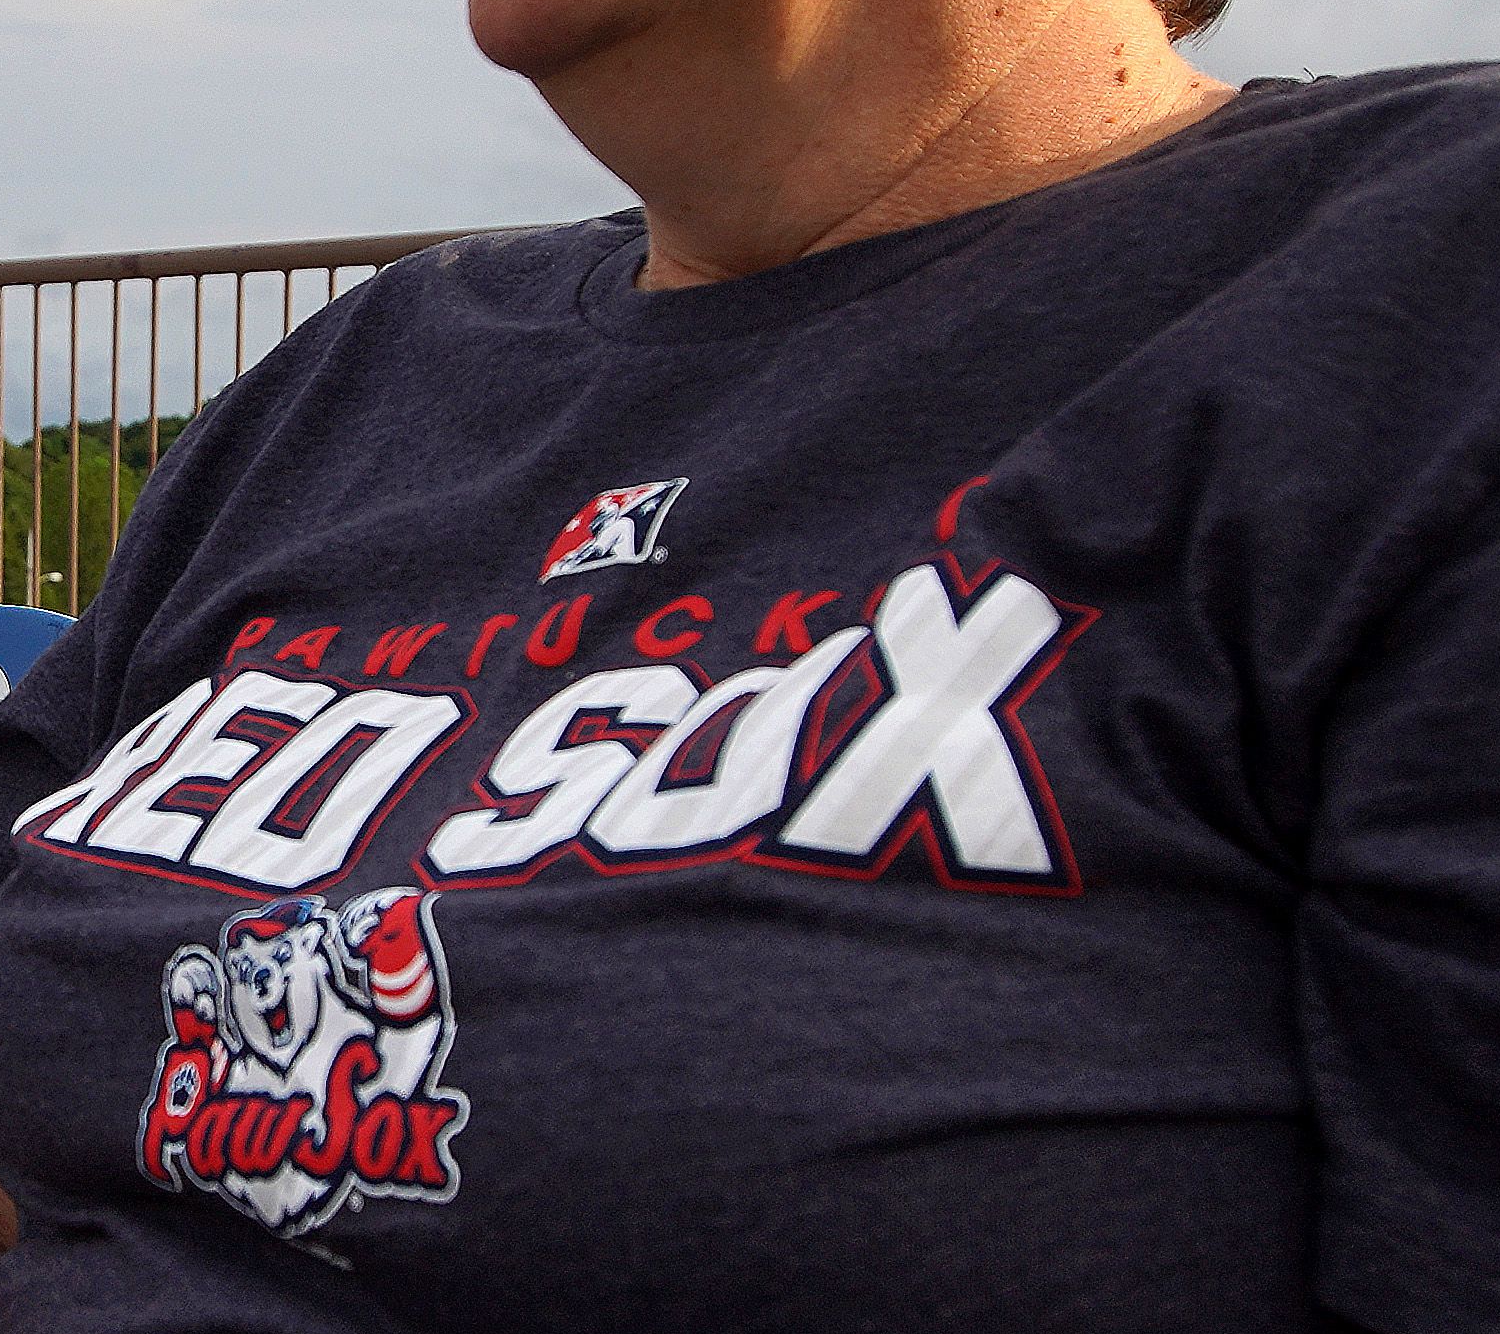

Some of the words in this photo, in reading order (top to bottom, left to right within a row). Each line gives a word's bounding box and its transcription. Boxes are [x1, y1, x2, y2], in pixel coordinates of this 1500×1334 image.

[12, 668, 475, 892] RED
[412, 552, 1102, 899] SOX
[143, 1039, 458, 1187] PawSox
